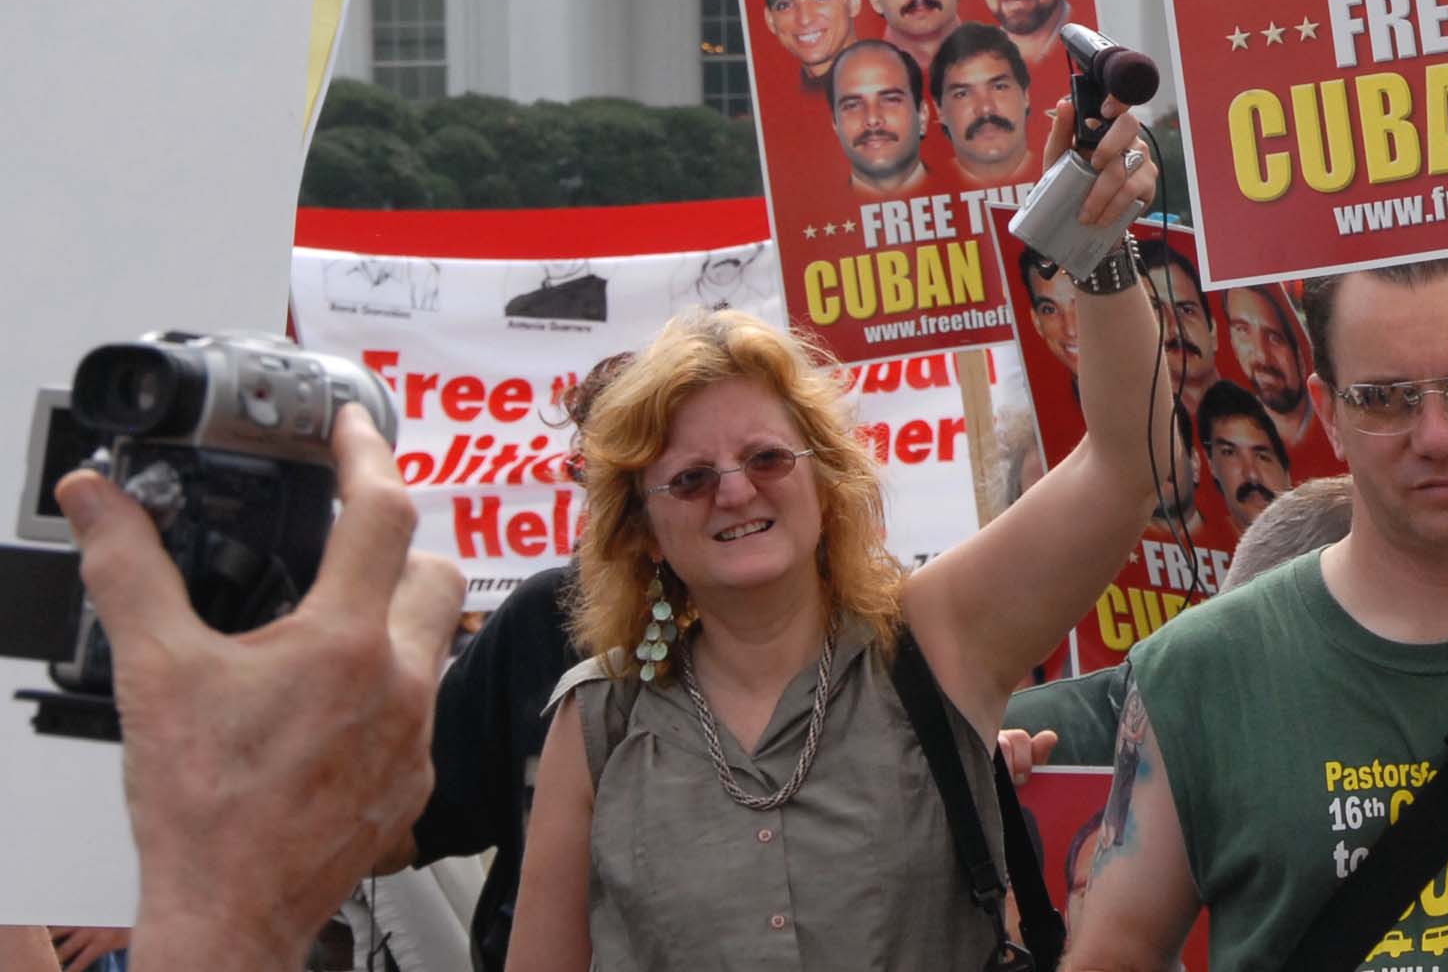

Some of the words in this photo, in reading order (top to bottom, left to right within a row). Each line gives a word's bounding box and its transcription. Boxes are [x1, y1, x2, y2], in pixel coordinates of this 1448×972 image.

[860, 194, 956, 249] FREE
[804, 240, 986, 326] CUBAN
[864, 305, 1012, 343] www.freethefi
[396, 434, 572, 486] olitic
[453, 490, 575, 559] Hel
[1329, 796, 1385, 832] 16th
